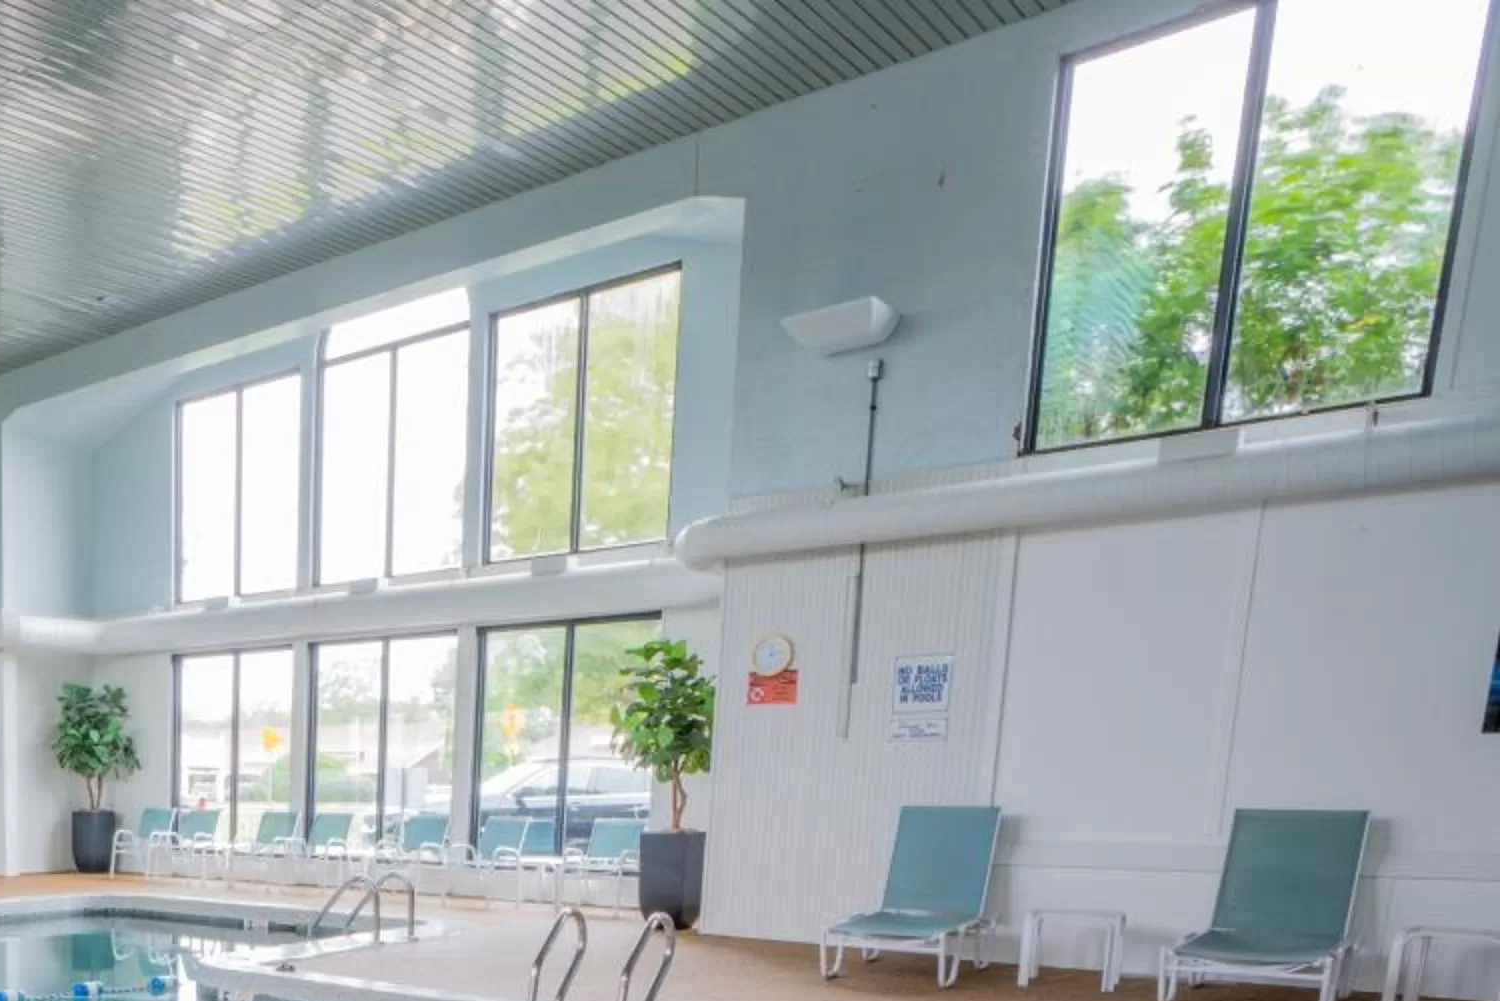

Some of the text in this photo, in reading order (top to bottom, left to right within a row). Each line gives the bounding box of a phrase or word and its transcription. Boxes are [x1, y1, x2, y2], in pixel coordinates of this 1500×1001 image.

[897, 663, 948, 674] NO BALLS
[900, 683, 943, 693] ALLOWED
